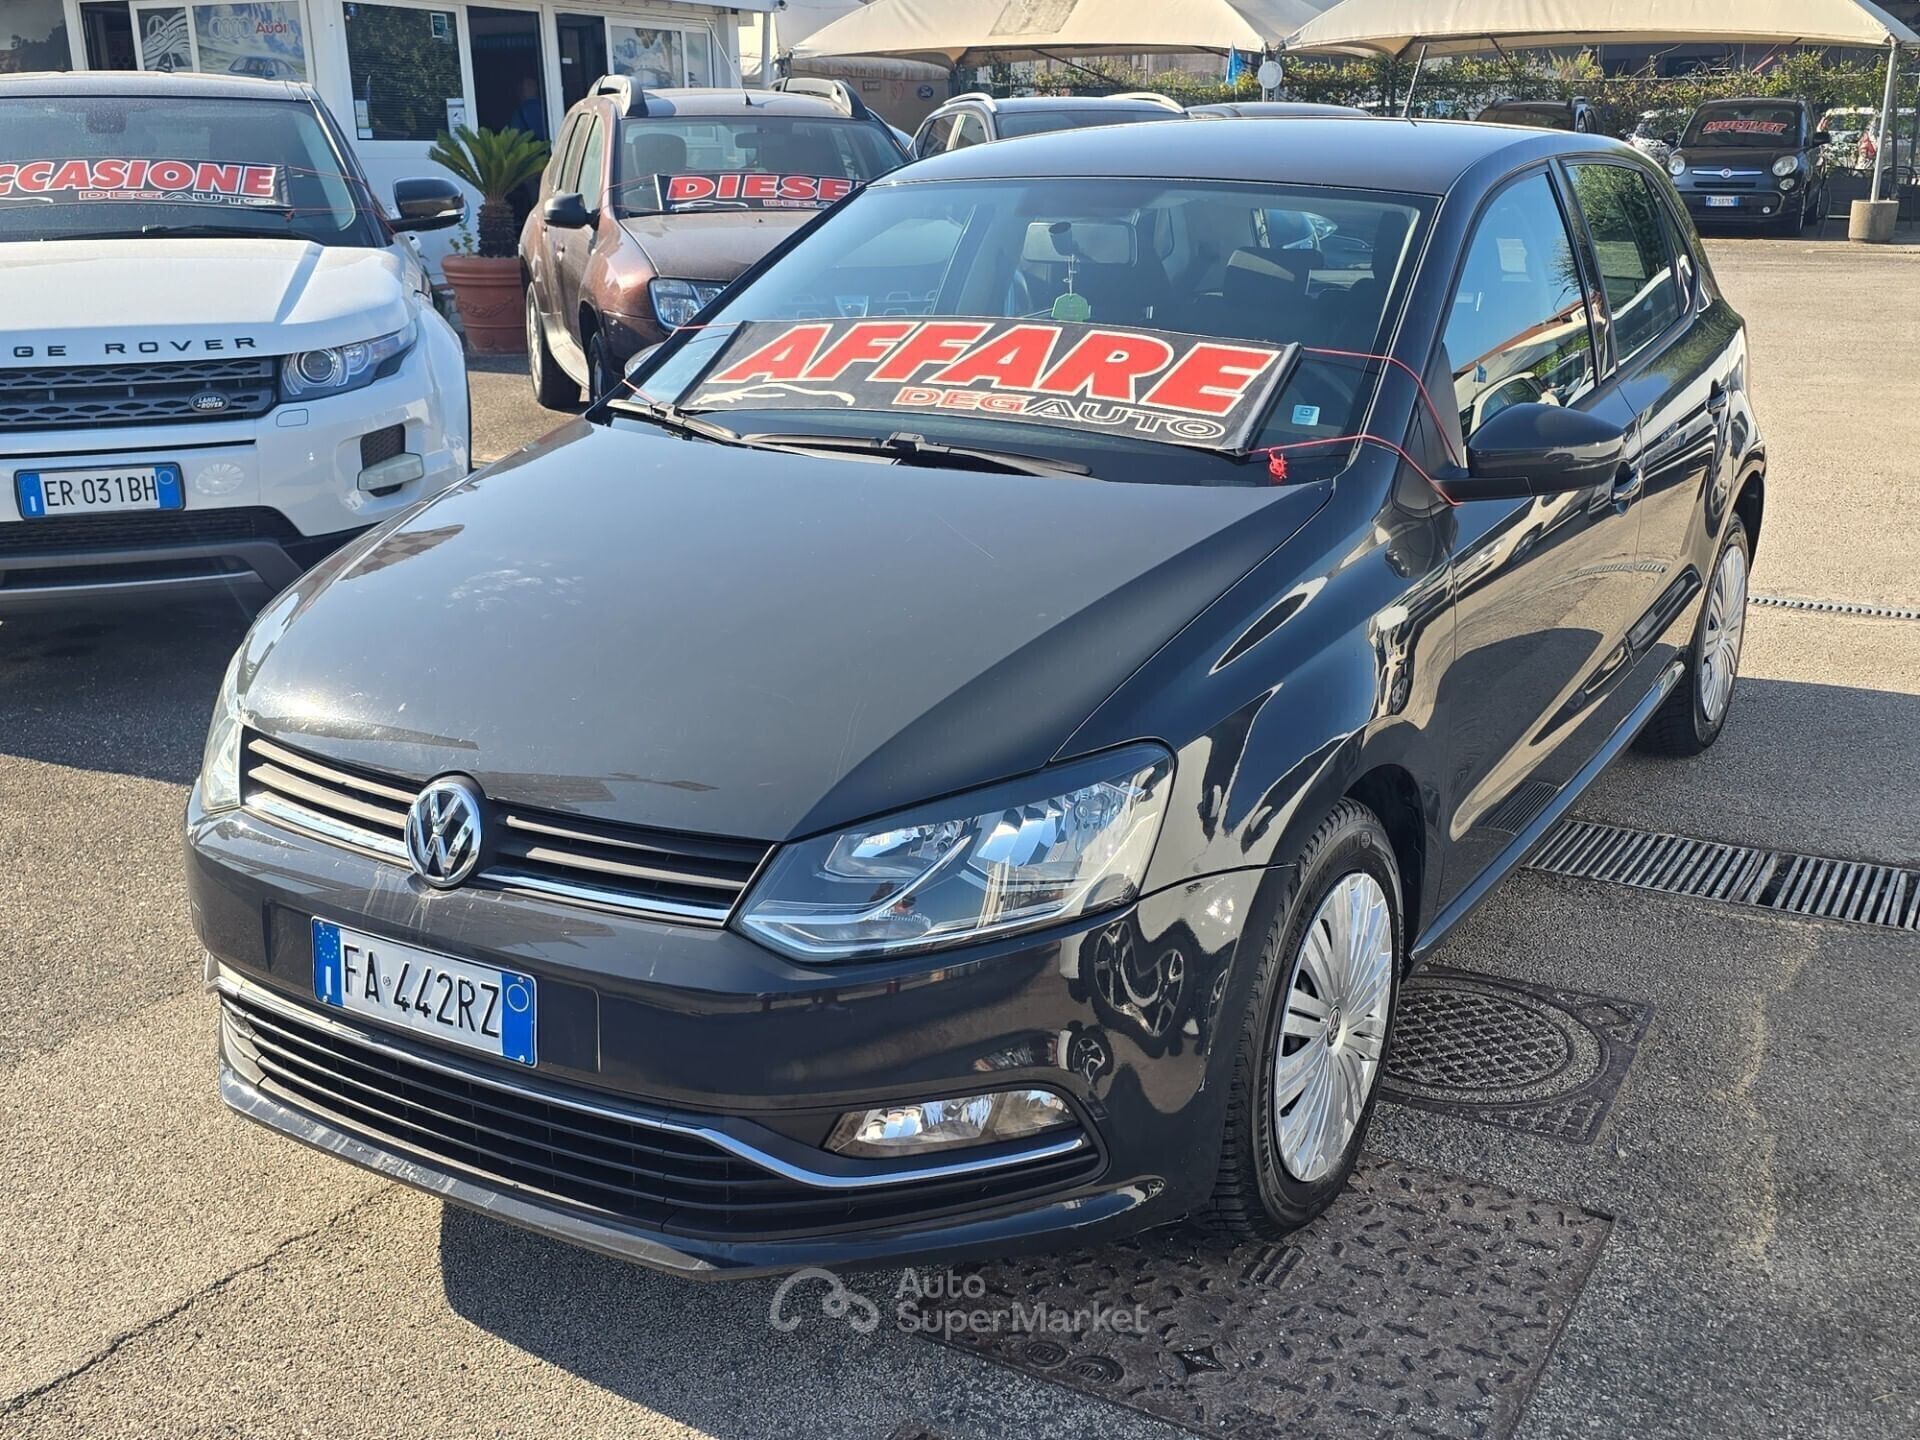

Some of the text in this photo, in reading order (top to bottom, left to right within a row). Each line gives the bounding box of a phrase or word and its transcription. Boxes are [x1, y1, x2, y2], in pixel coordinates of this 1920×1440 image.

[79, 190, 276, 206] DEGAUTO
[667, 174, 865, 201] DIESE
[13, 337, 257, 358] GE ROVER
[704, 321, 1282, 418] AFFARE
[891, 386, 1226, 440] DEGAUTO
